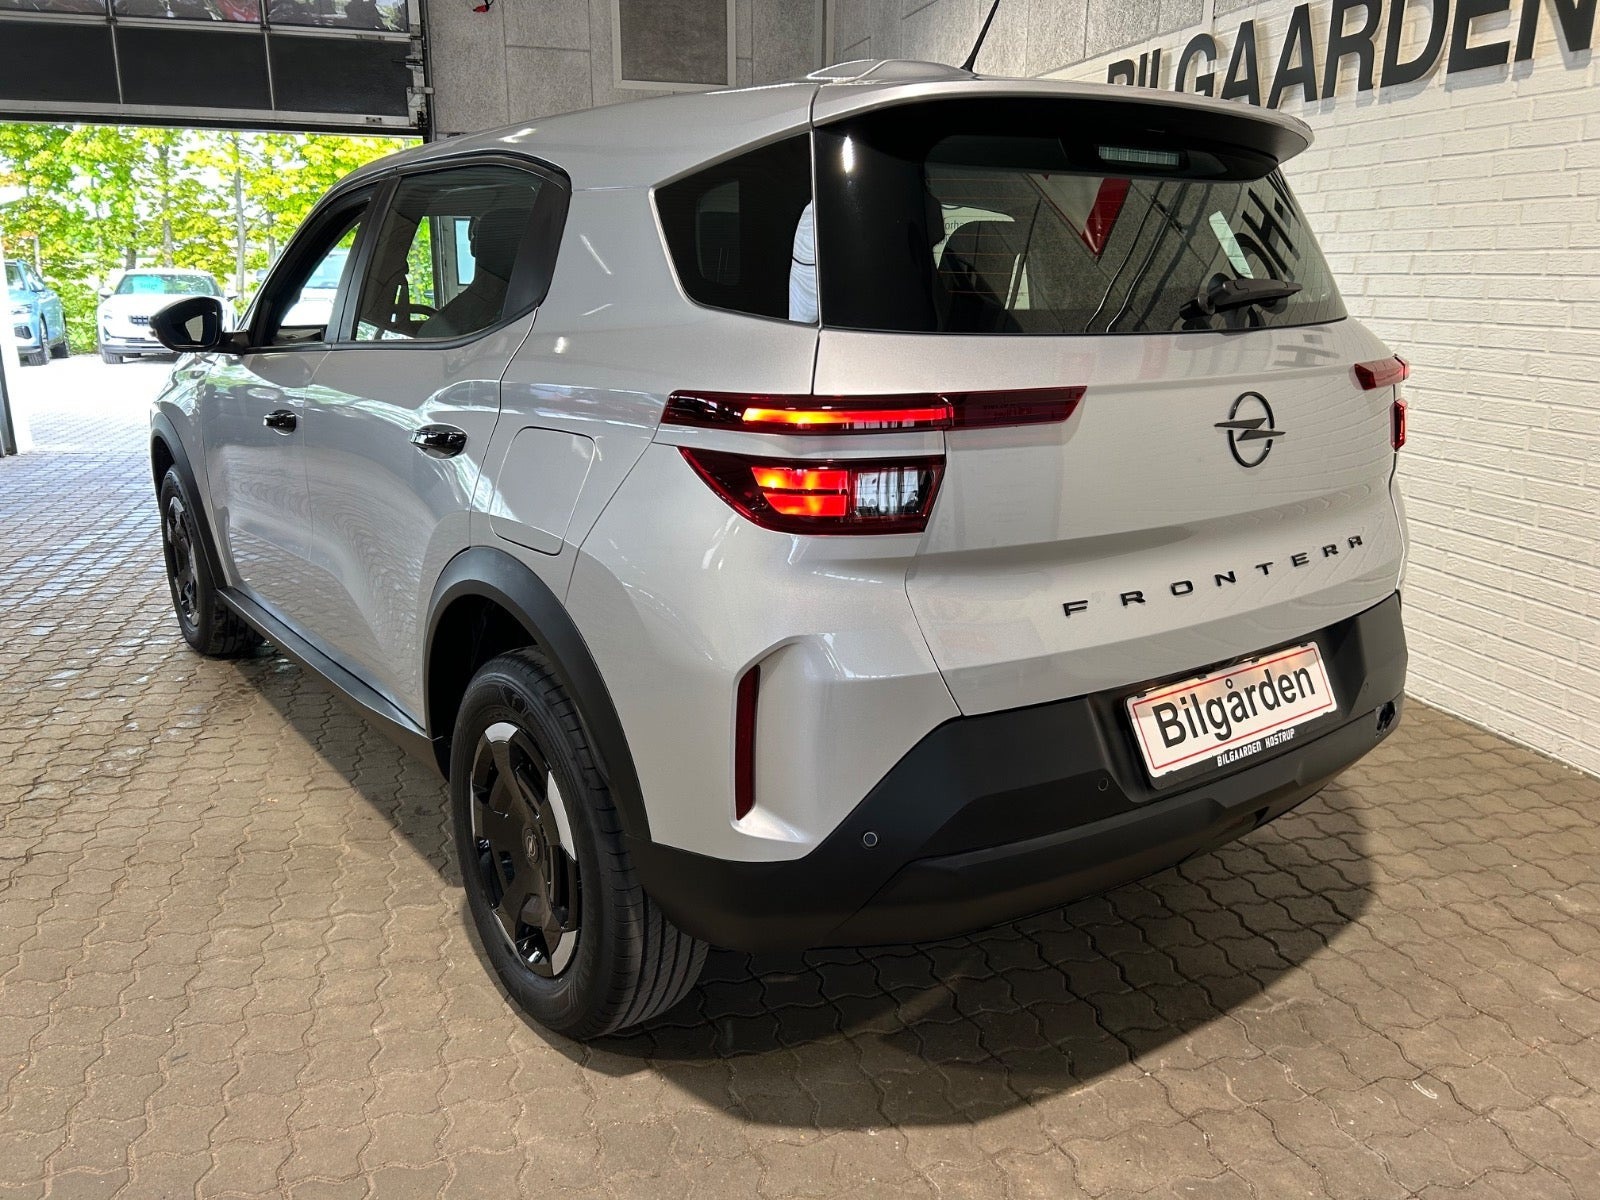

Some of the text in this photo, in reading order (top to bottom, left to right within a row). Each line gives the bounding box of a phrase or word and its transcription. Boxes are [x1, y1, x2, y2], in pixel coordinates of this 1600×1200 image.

[1063, 535, 1363, 616] FRONTERA
[1152, 666, 1316, 749] Bilgården
[1217, 728, 1295, 767] BILGAARDEN HOSTRUP
